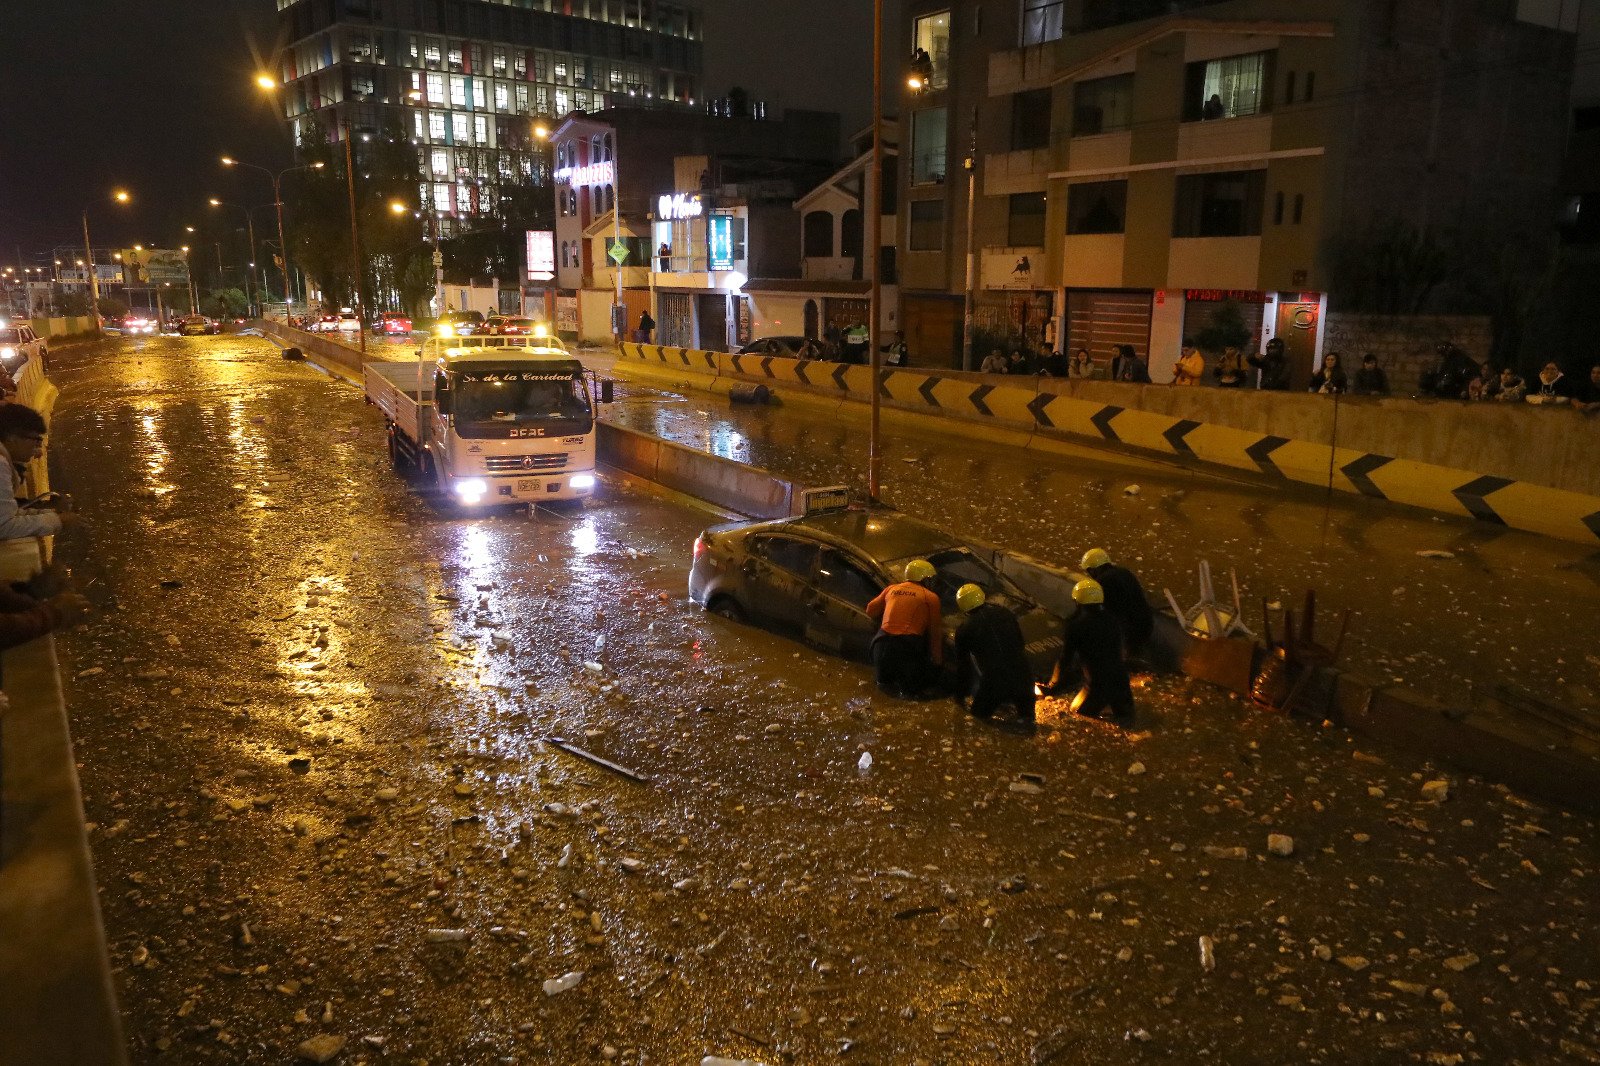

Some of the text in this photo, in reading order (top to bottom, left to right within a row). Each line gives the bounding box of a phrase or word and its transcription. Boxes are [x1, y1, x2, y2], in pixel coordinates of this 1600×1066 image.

[462, 372, 573, 383] Sr. de la Caridad
